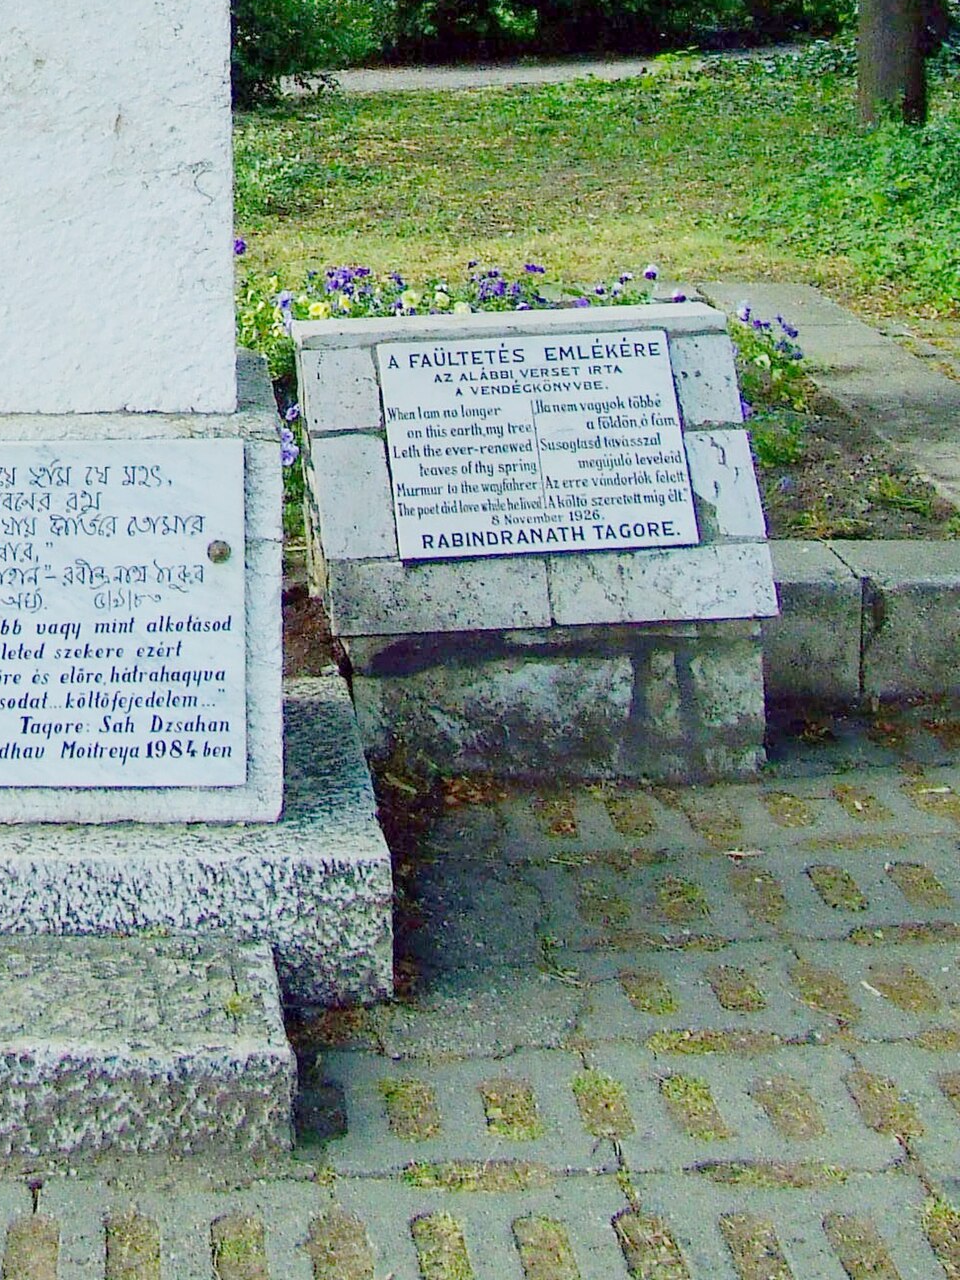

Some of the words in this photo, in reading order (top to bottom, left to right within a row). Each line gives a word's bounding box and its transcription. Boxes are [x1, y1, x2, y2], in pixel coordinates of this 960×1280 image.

[387, 354, 399, 371] A
[409, 343, 525, 367] FAÜLTETÉS
[544, 337, 661, 362] EMLÉKÉRE
[433, 372, 453, 383] AZ
[459, 367, 514, 381] ALÁBBI
[519, 367, 581, 378] VERSET
[588, 365, 623, 375] IRTA
[455, 387, 463, 396] A
[443, 407, 458, 418] no
[461, 405, 502, 419] longer
[579, 396, 626, 414] vagyok
[407, 428, 423, 439] on
[425, 425, 447, 438] this
[586, 419, 594, 430] a
[423, 442, 442, 457] the
[445, 439, 533, 456] ever-renewed
[635, 450, 683, 465] leveleid
[461, 461, 472, 475] of
[474, 462, 494, 476] thy
[498, 459, 537, 475] spring
[545, 475, 560, 489] Az
[562, 477, 589, 489] erre
[655, 470, 685, 483] felett
[396, 483, 443, 497] Murmur
[447, 481, 458, 495] to
[461, 481, 479, 494] the
[397, 503, 415, 517] The
[417, 504, 439, 519] poet
[440, 500, 457, 514] did
[459, 500, 479, 513] love
[548, 495, 556, 509] A
[591, 492, 641, 508] szeretett
[491, 516, 500, 526] 8
[504, 512, 563, 526] November
[568, 509, 606, 522] 1926.
[421, 526, 584, 550] RABINDRANATH
[592, 521, 681, 541] TAGORE.
[95, 617, 135, 634] mint
[146, 615, 232, 633] alkotásod
[54, 642, 124, 659] szekere
[136, 640, 183, 658] ezért
[31, 669, 49, 685] és
[99, 715, 135, 734] Sah
[150, 714, 231, 733] Dzsahan
[61, 741, 140, 765] Moitreya
[145, 739, 198, 759] 1984
[203, 741, 232, 759] ben
